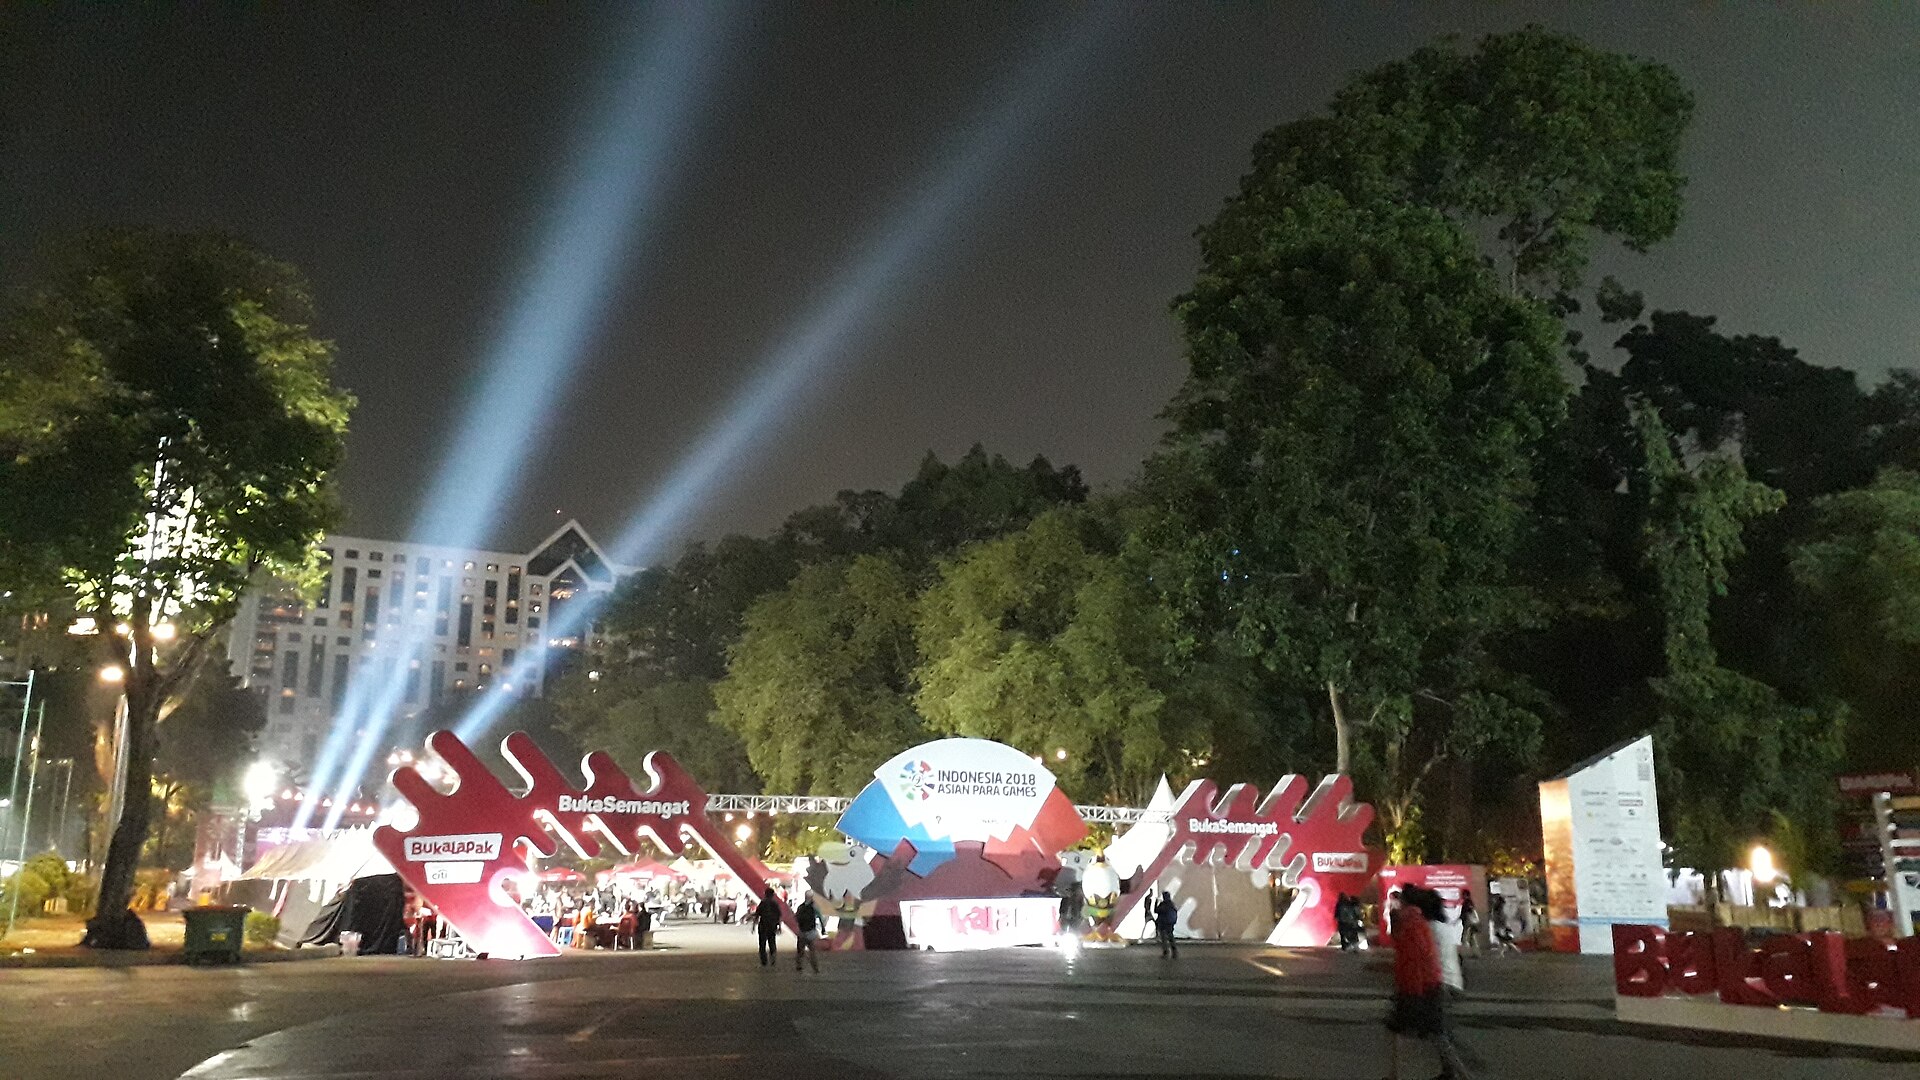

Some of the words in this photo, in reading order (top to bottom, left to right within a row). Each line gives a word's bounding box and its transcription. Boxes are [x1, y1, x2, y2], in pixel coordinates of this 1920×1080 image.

[938, 770, 1002, 784] INDONESIA
[1005, 772, 1036, 785] 2018
[938, 784, 970, 795] ASIAN
[973, 785, 1000, 796] PARA
[1003, 786, 1037, 797] GAMES
[558, 795, 690, 819] BukaSemangat
[1189, 818, 1278, 838] BukaSemangat
